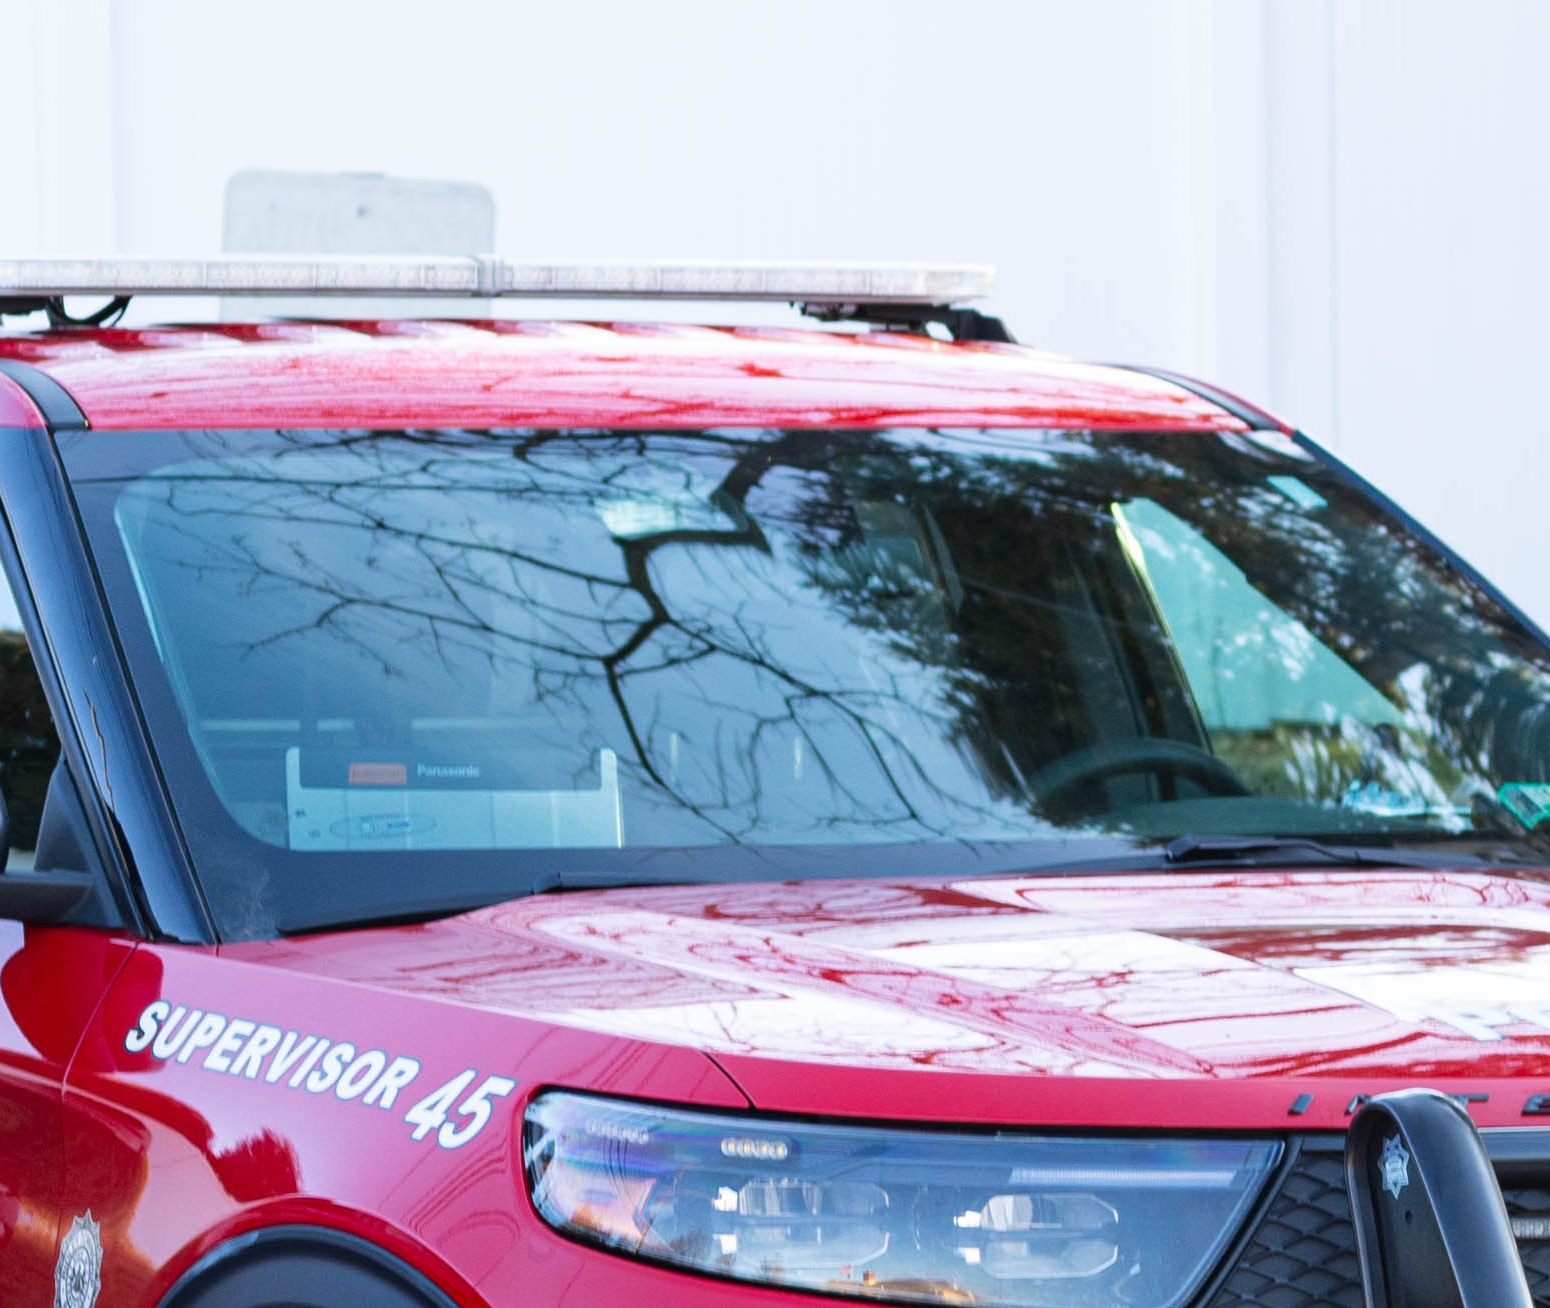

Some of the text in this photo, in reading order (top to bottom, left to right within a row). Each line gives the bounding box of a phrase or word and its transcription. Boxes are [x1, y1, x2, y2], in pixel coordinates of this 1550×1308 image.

[417, 763, 480, 777] Panasonic
[125, 1000, 516, 1150] SUPERVISOR 45
